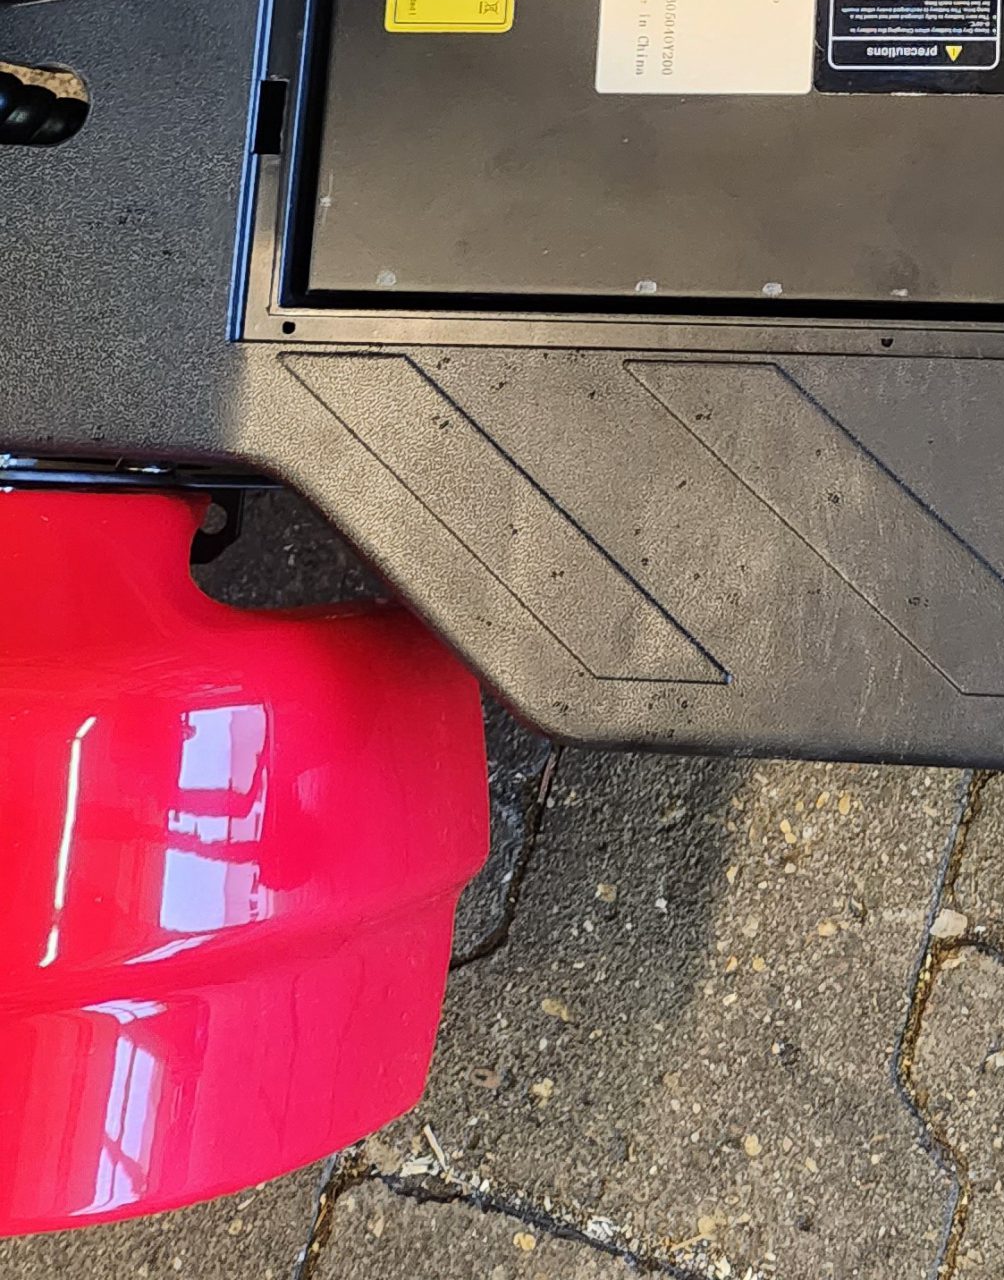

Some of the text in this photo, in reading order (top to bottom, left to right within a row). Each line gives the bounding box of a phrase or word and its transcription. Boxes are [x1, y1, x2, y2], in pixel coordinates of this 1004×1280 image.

[639, 14, 650, 27] in
[636, 36, 649, 75] China
[867, 45, 938, 58] precautions
